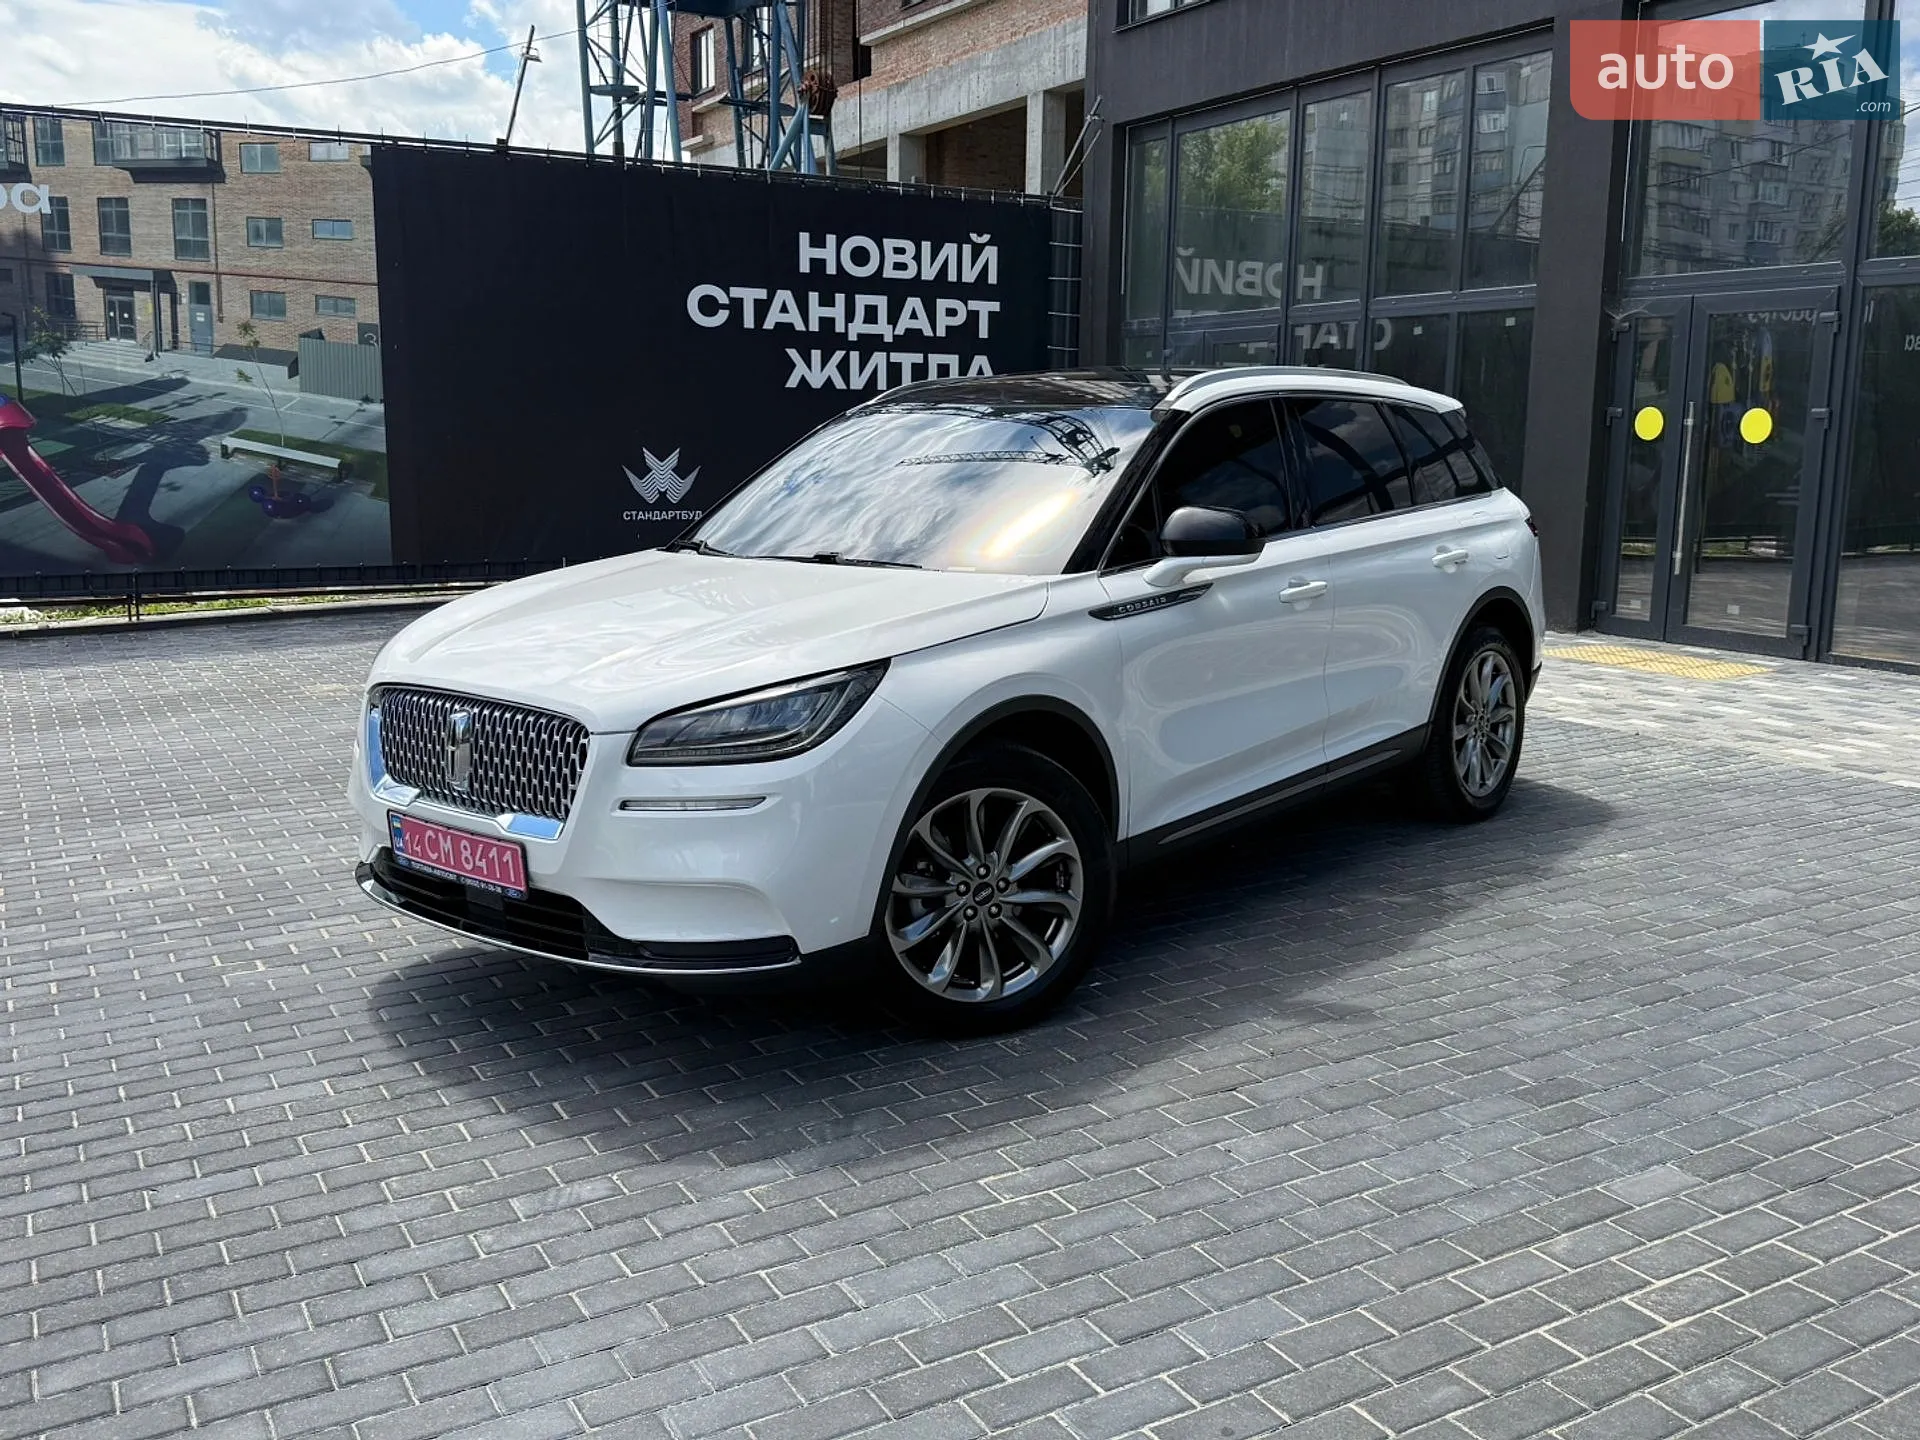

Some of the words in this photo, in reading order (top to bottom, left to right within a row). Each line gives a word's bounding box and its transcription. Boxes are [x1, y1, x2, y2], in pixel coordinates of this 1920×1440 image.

[798, 231, 999, 285] НОВИЙ
[686, 284, 1001, 342] СТАНДАРТ
[622, 510, 703, 521] СТАНДАРТБУД
[405, 831, 423, 858] 14
[425, 830, 455, 866] CM
[460, 840, 515, 882] 8411
